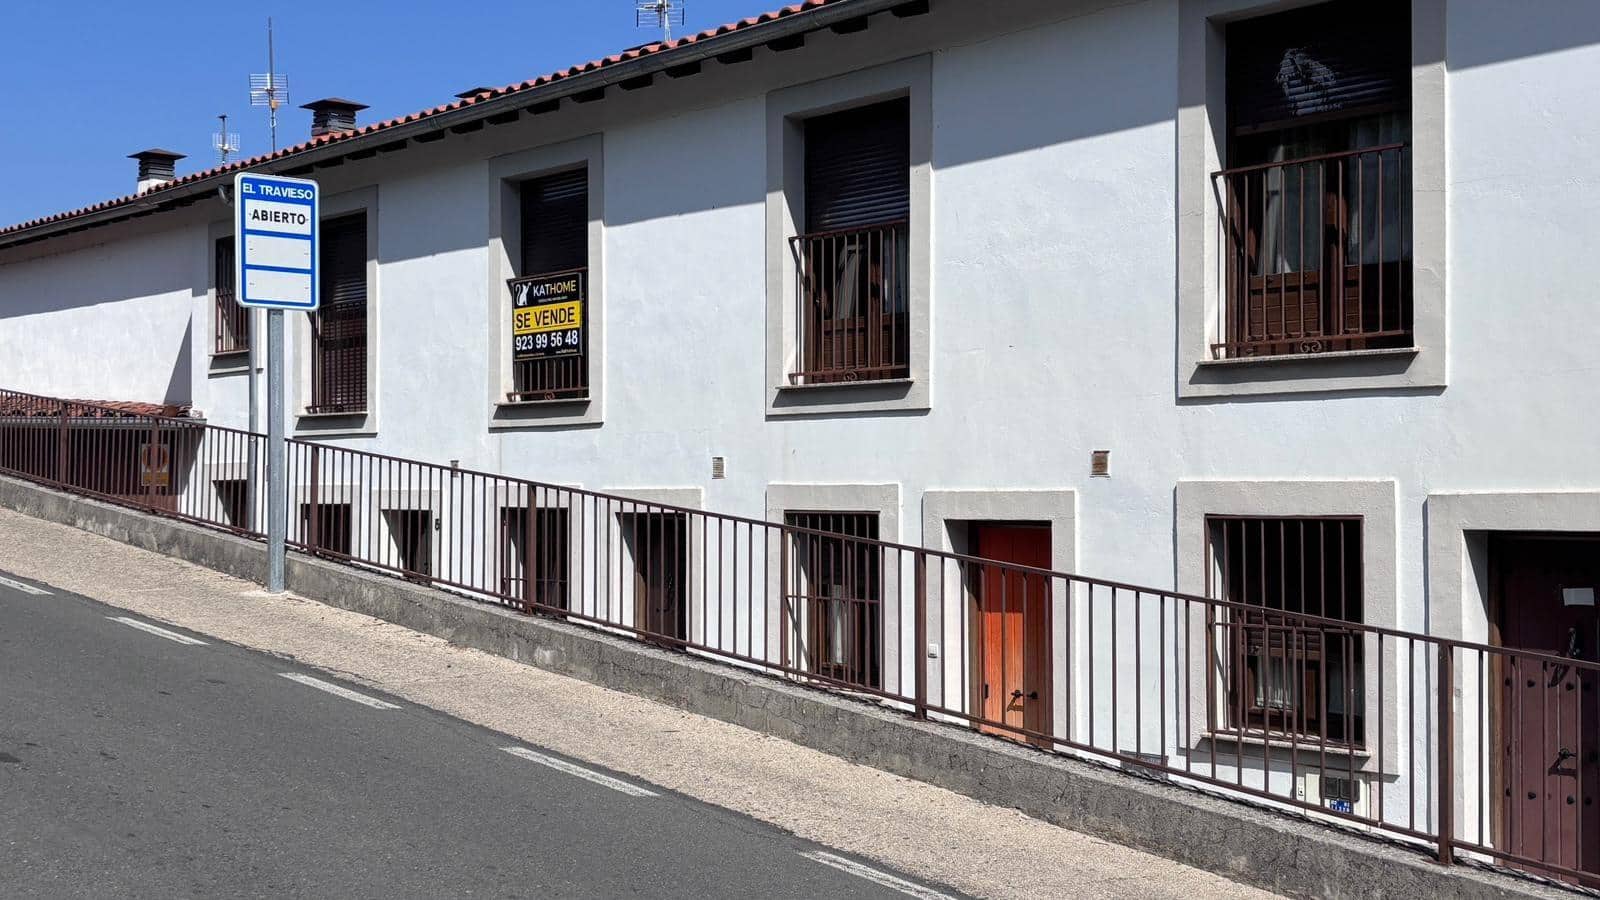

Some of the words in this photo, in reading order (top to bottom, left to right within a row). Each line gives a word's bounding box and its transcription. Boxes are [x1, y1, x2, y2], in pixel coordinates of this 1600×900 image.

[243, 183, 256, 194] EL
[258, 185, 313, 200] TRAVIESO
[252, 209, 306, 225] ABIERTO
[533, 280, 577, 297] KATHOME
[516, 312, 531, 329] SE
[534, 306, 575, 327] VENDE
[515, 335, 533, 351] 923
[536, 333, 548, 349] 99
[551, 332, 563, 347] 56
[565, 330, 578, 345] 48
